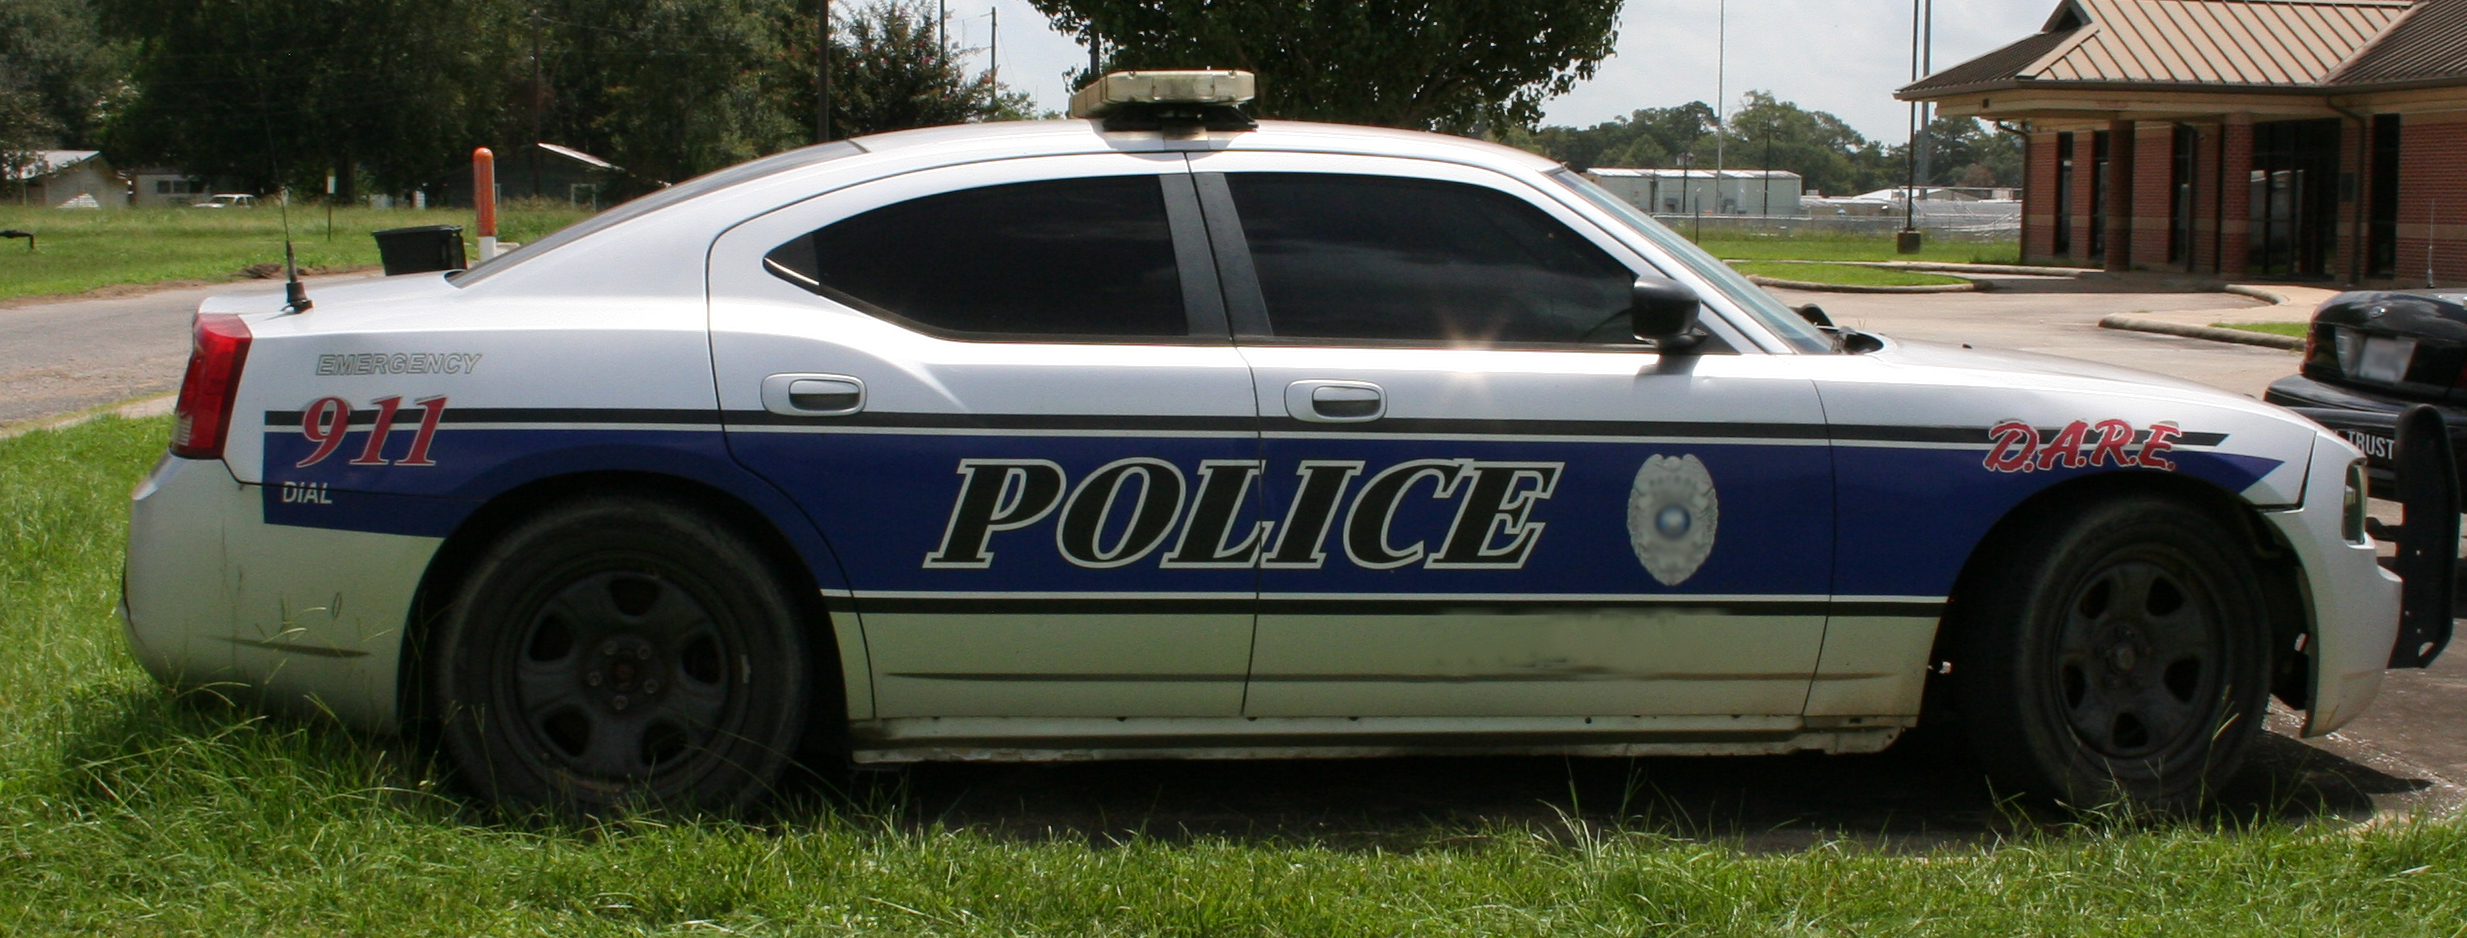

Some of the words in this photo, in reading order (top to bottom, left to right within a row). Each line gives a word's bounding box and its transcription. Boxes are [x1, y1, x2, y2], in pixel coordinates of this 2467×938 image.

[315, 353, 482, 376] EMERGENCY
[296, 395, 448, 468] 911
[281, 481, 333, 505] DIAL
[922, 457, 1565, 570] POLICE
